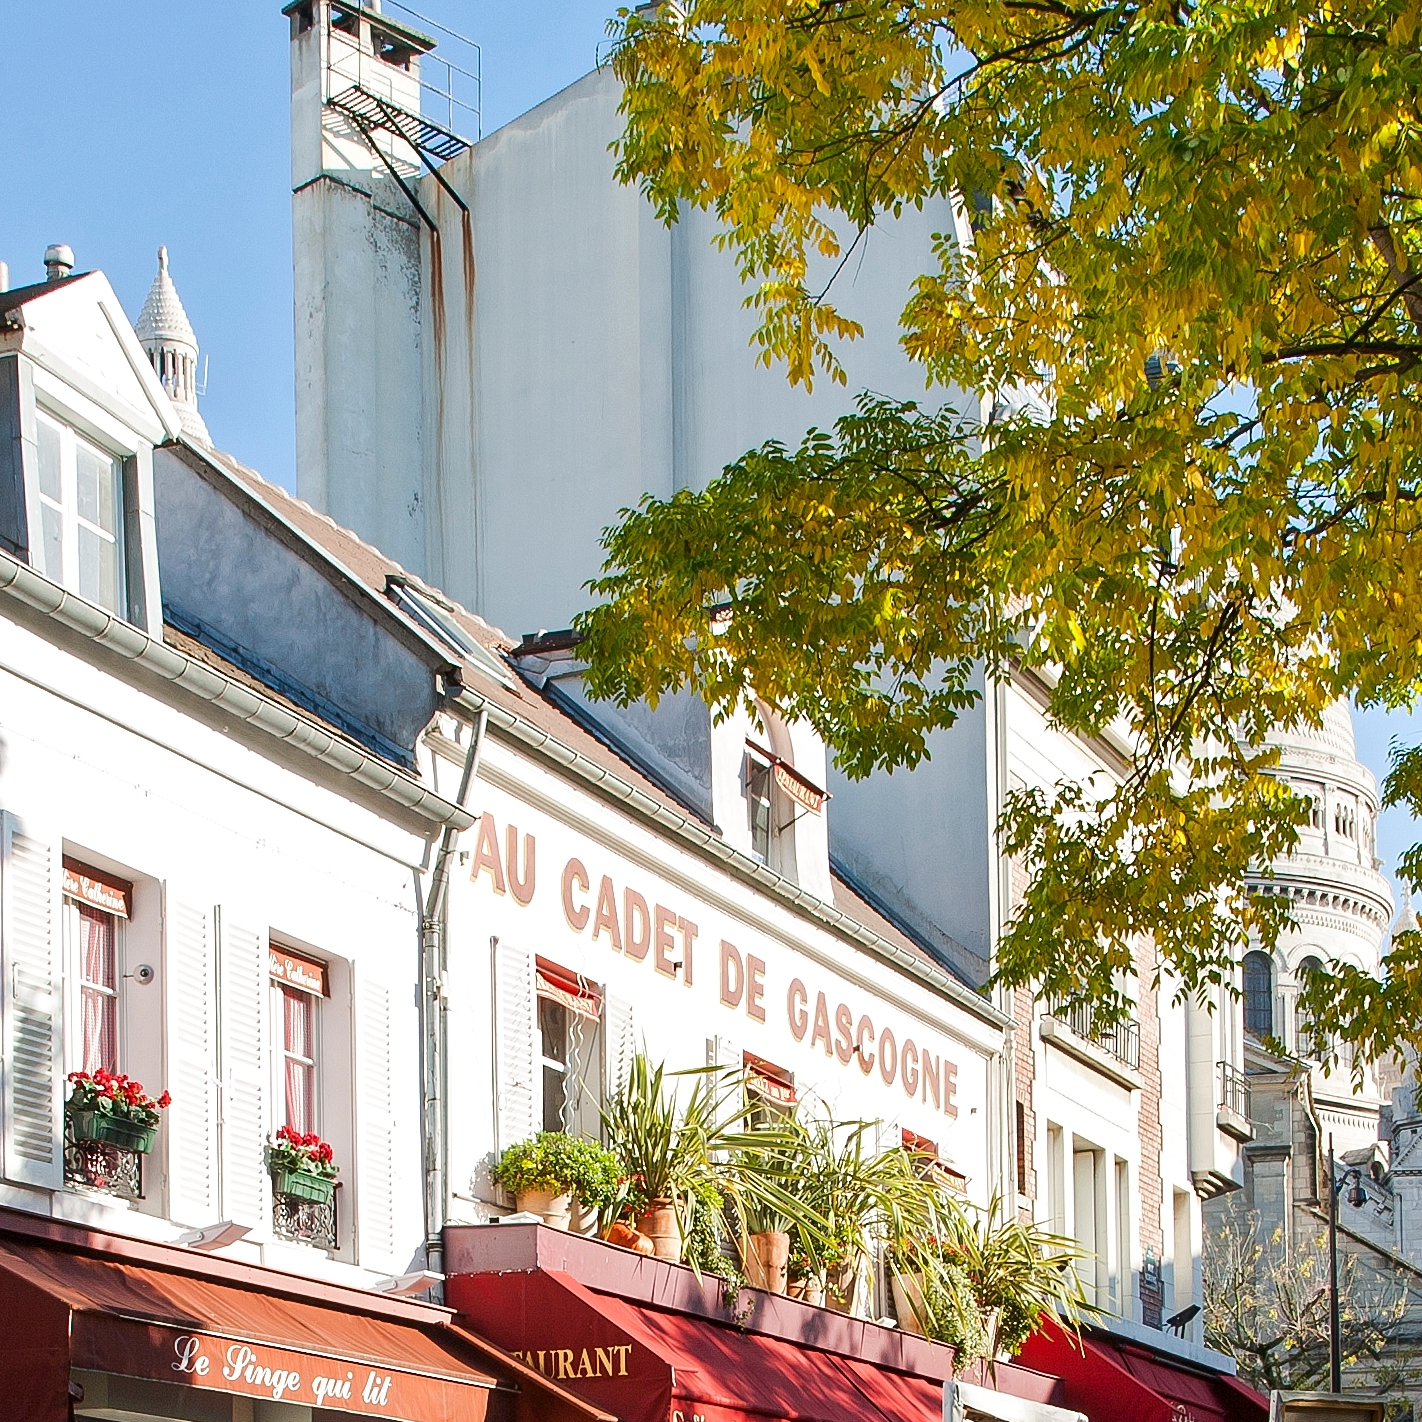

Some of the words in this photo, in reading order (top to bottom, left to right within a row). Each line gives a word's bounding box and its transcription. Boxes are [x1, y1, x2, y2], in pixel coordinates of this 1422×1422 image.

[80, 876, 125, 910] Catherine
[471, 810, 535, 906] AU
[561, 856, 699, 988] CADET
[719, 938, 766, 1023] DE
[786, 978, 959, 1119] GASCOGNE
[171, 1336, 210, 1376] Le
[223, 1344, 301, 1398] Singe
[312, 1371, 354, 1406] qui
[362, 1376, 393, 1407] lit
